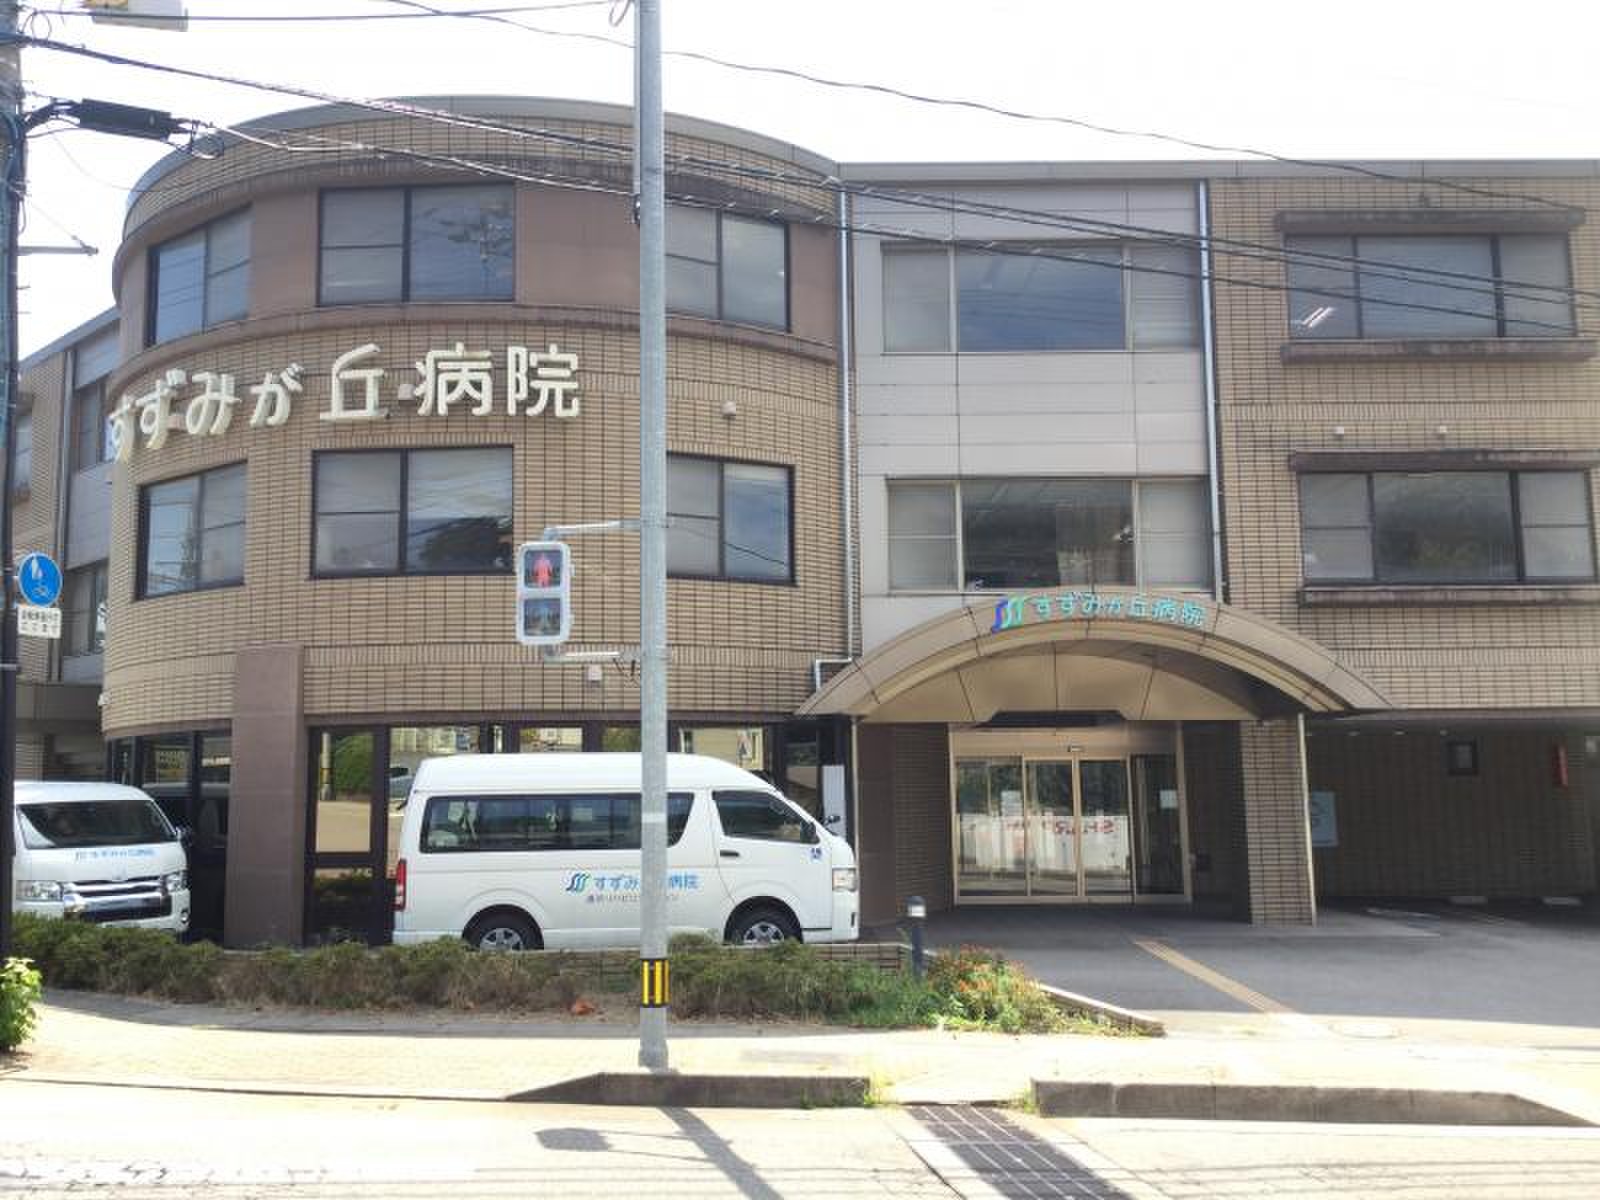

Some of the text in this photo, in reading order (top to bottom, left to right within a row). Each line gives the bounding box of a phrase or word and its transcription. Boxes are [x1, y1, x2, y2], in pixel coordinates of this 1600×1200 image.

[107, 342, 580, 464] すずみが丘病院
[595, 873, 698, 890] すずみ病院
